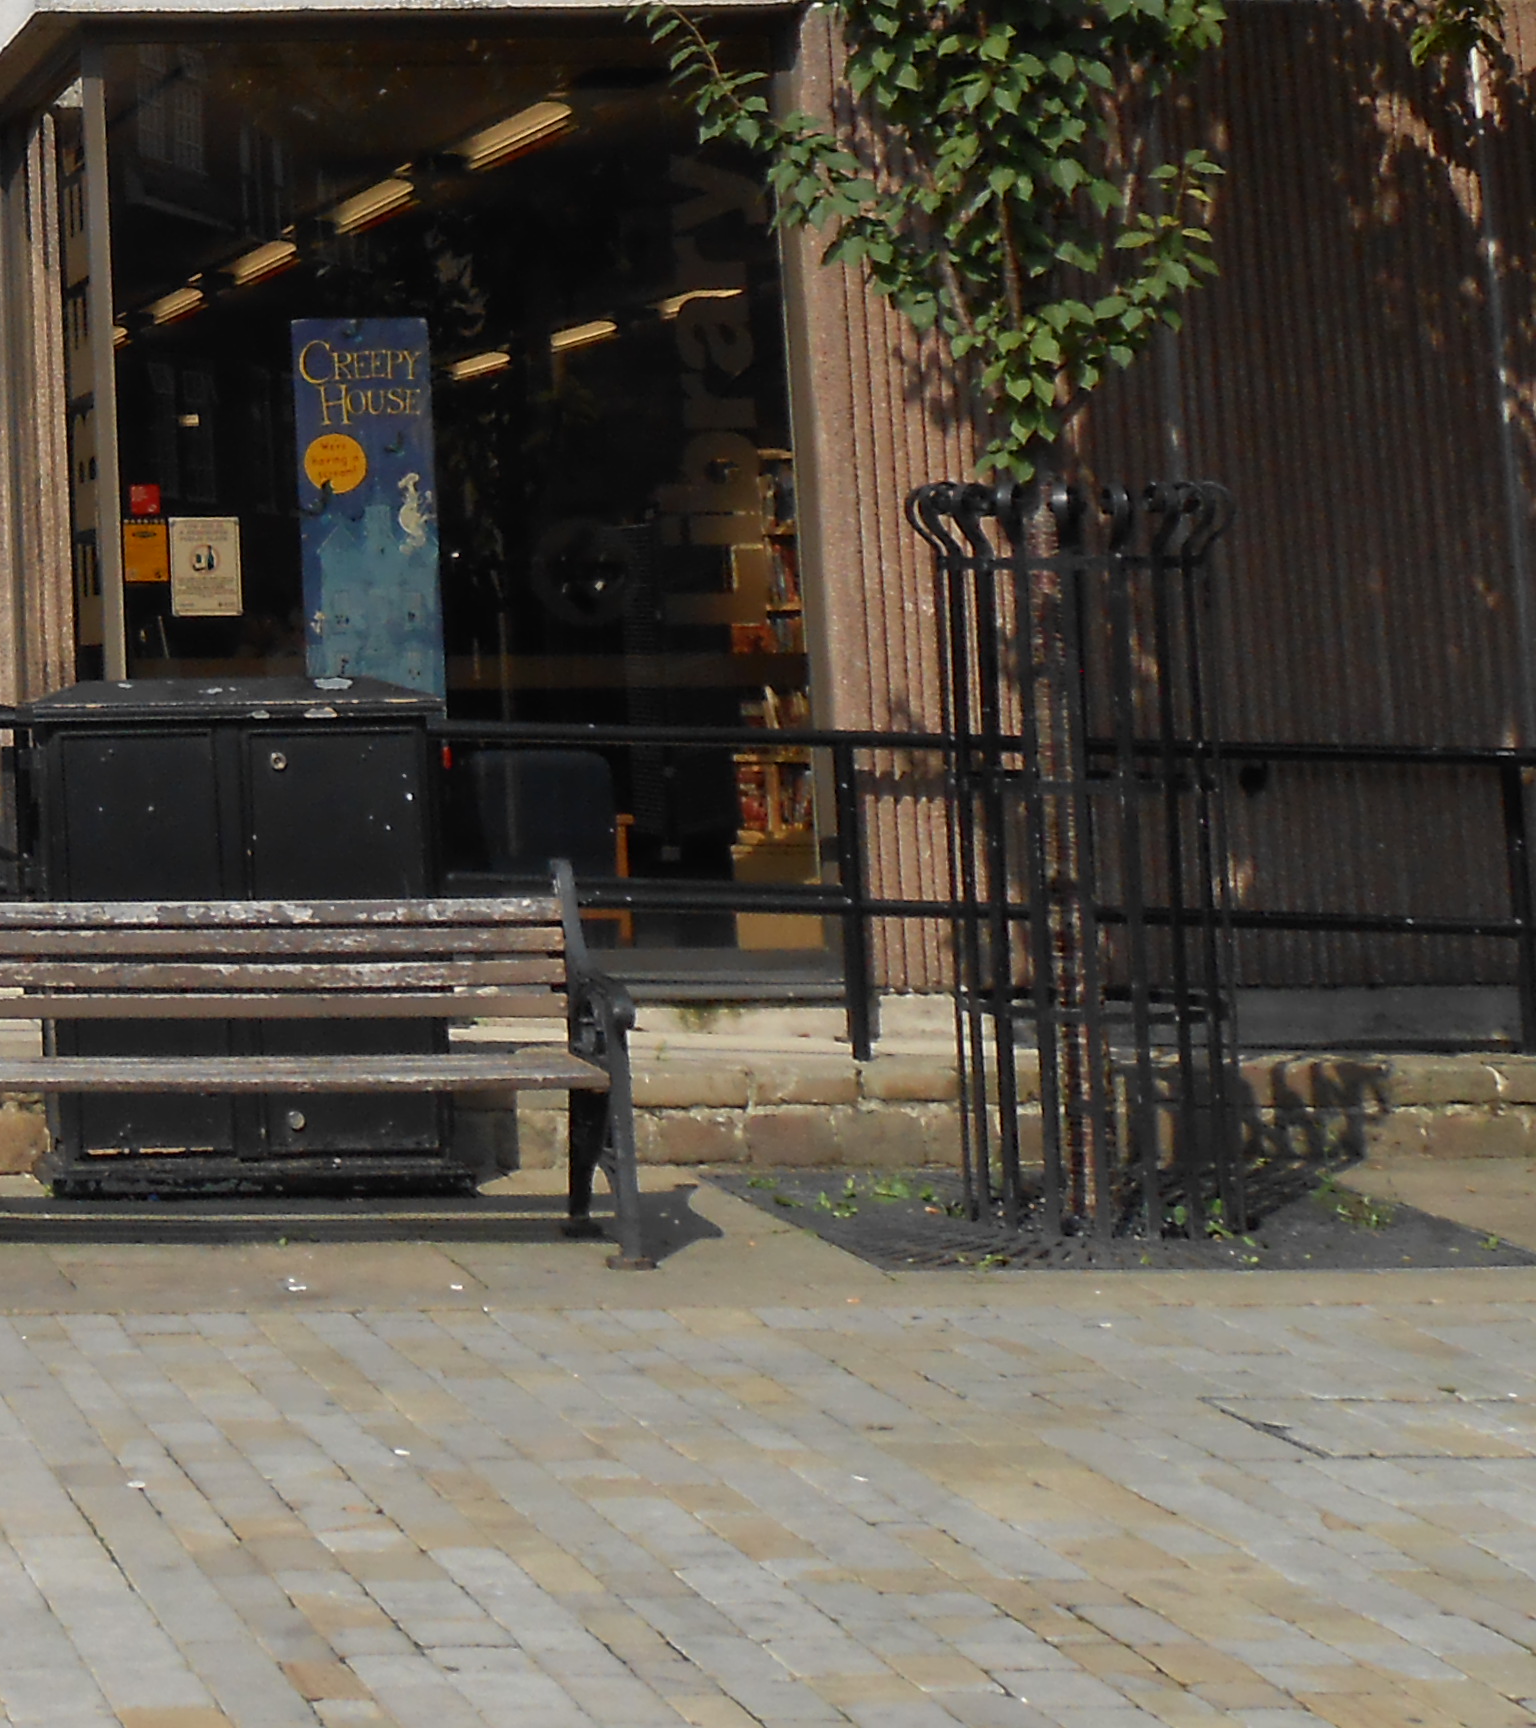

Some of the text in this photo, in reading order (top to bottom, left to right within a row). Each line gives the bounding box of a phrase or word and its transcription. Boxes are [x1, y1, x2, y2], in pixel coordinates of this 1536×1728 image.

[299, 340, 422, 384] CREEPY
[316, 384, 421, 425] HOUSE
[655, 154, 770, 626] Library
